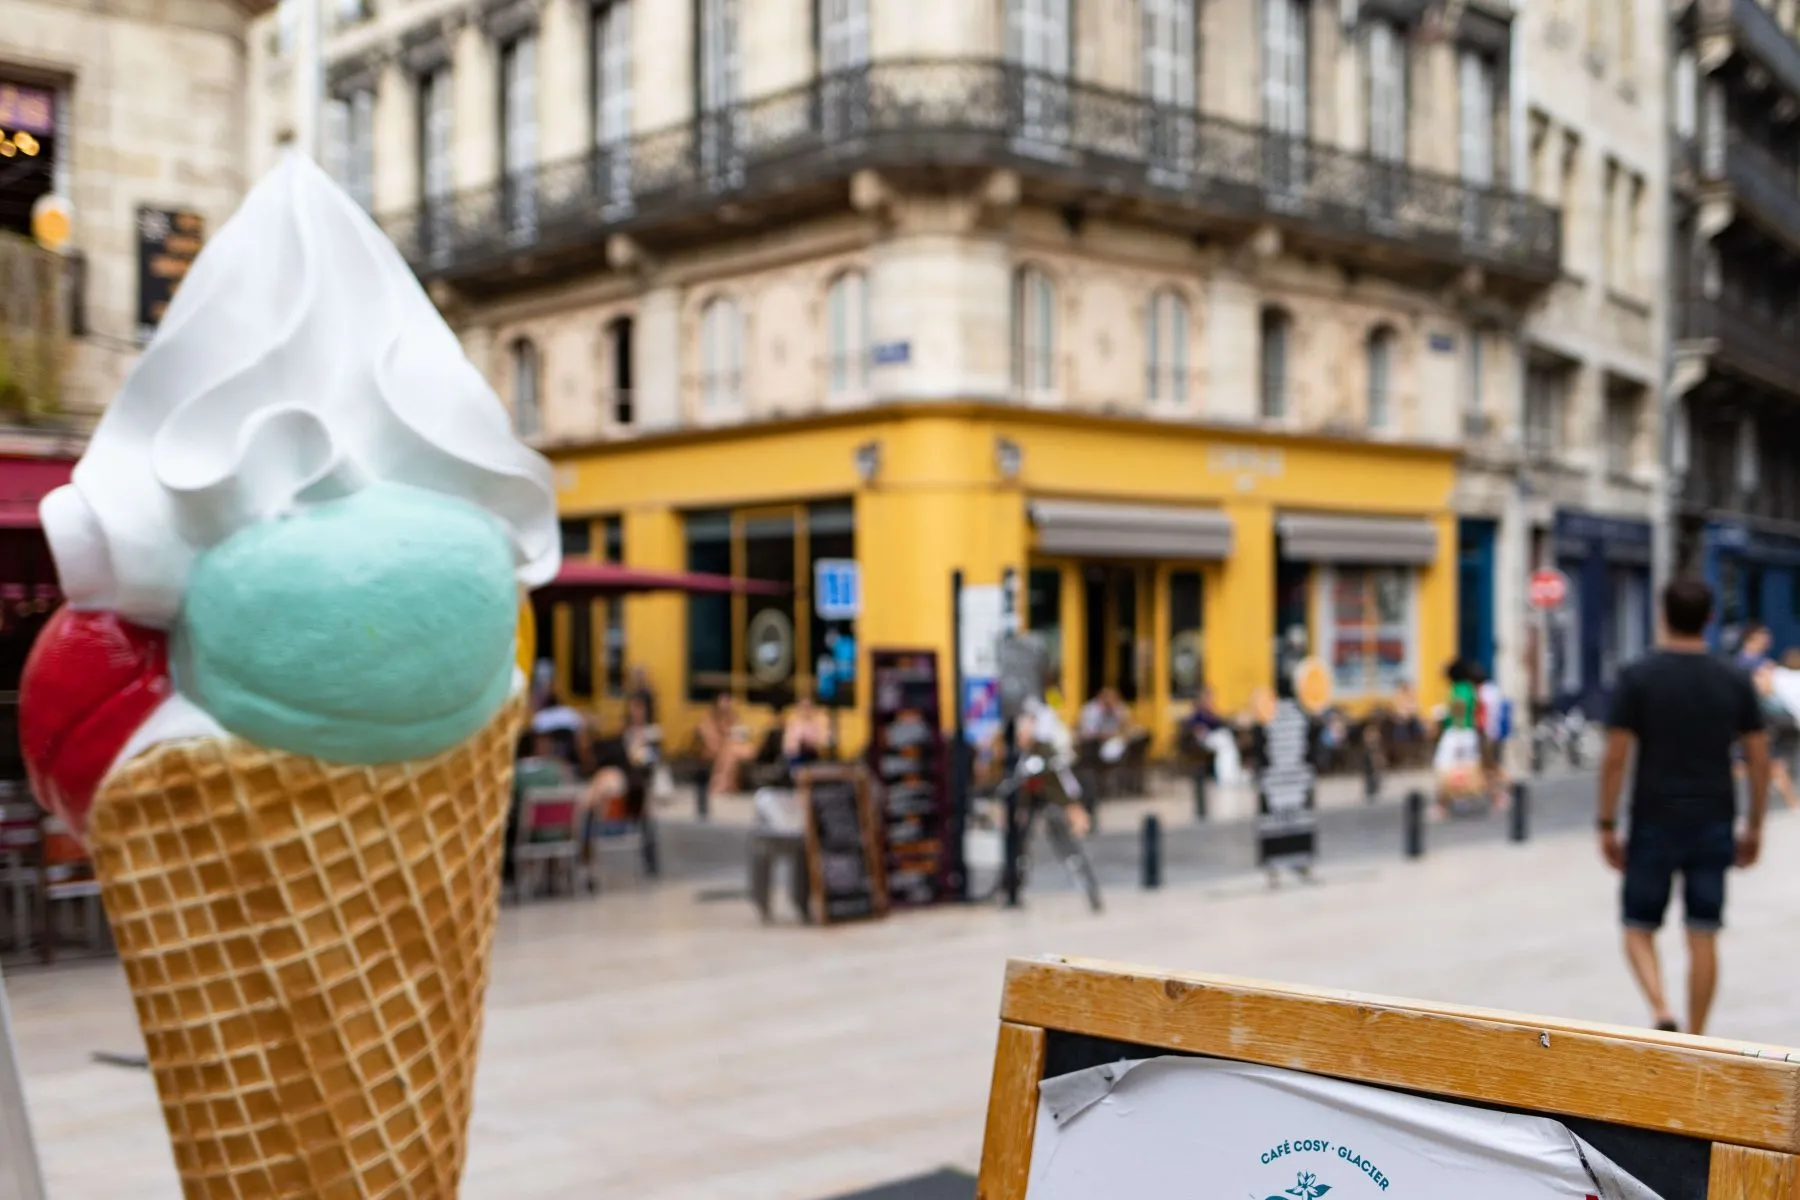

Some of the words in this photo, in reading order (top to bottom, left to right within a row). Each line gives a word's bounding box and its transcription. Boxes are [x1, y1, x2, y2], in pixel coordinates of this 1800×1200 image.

[1260, 1139, 1291, 1165] CAFÉ
[1293, 1139, 1329, 1152] COSY
[1337, 1146, 1390, 1191] GLACIER
